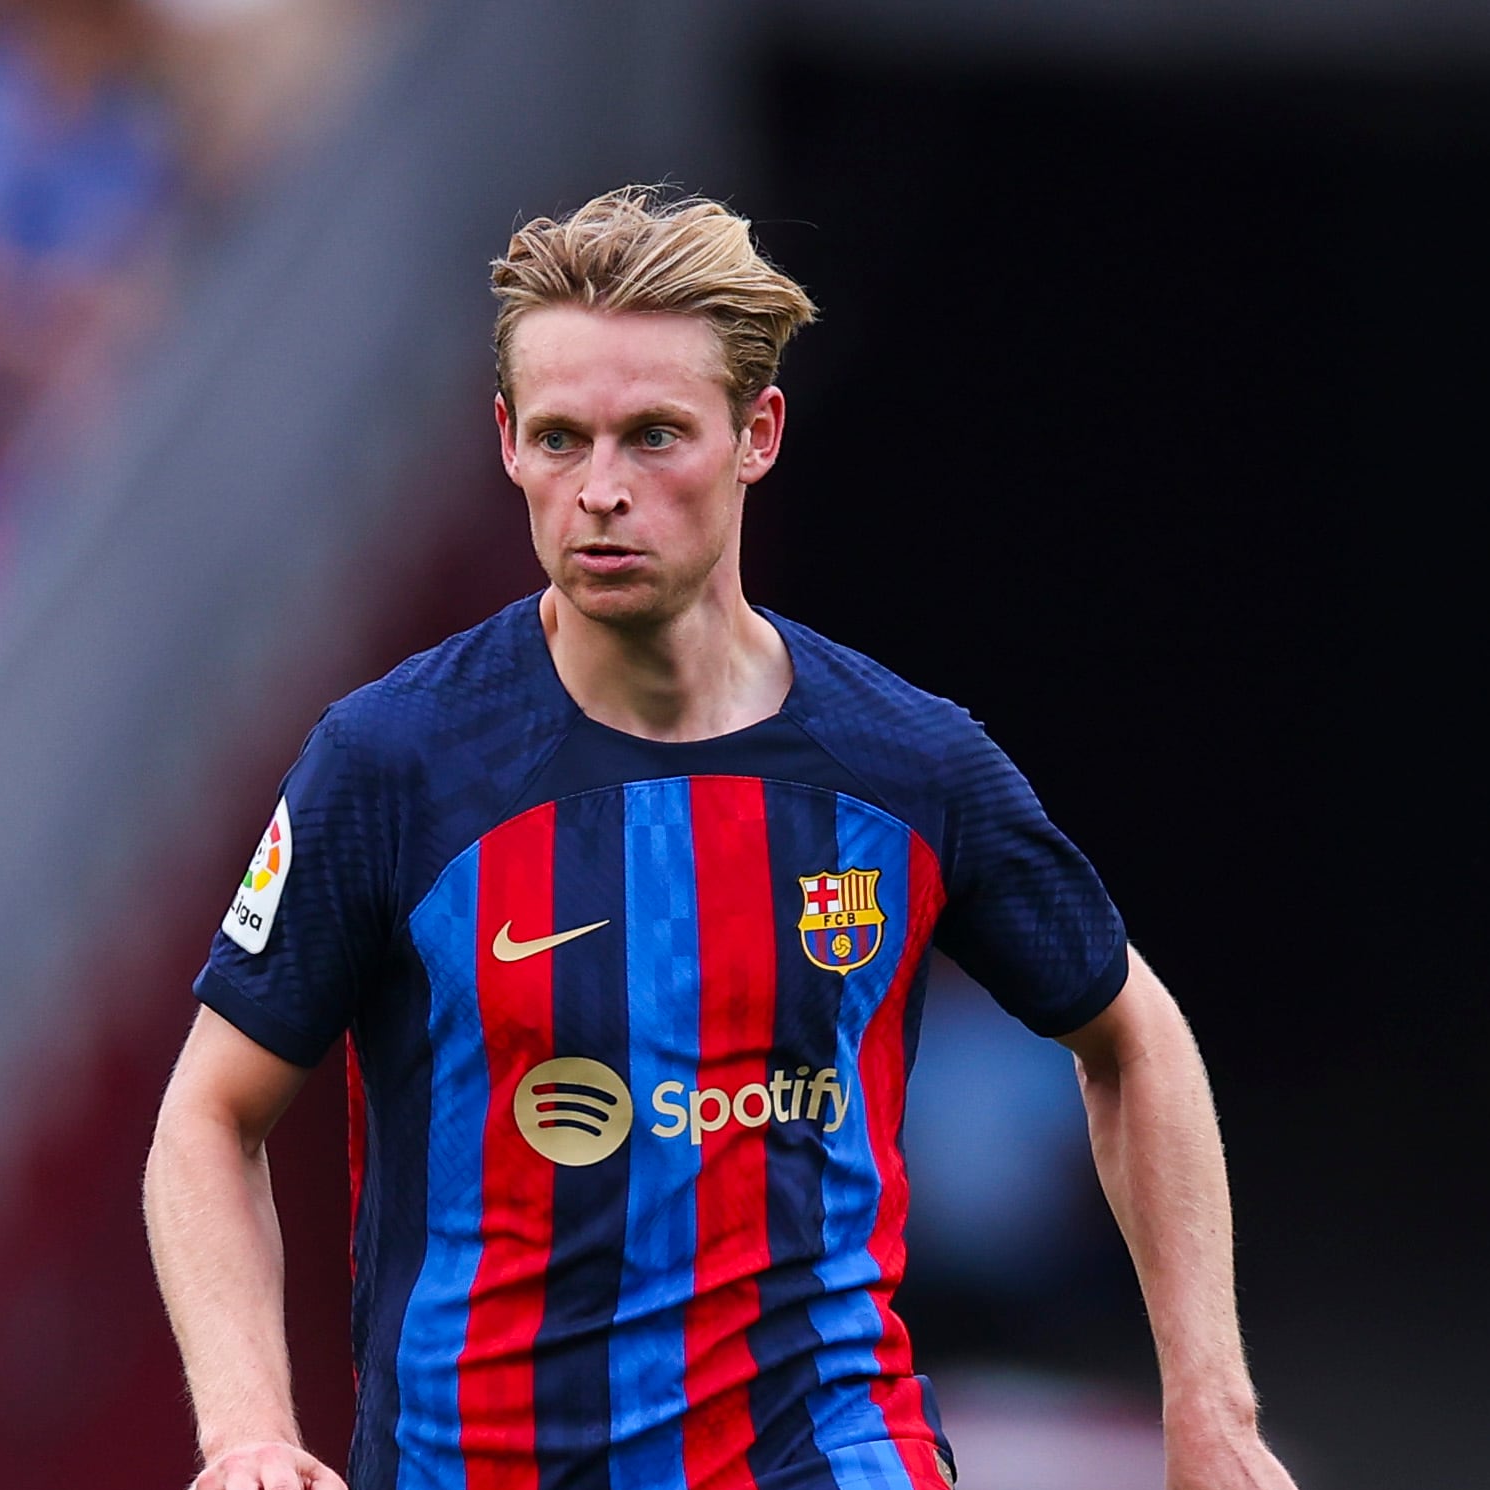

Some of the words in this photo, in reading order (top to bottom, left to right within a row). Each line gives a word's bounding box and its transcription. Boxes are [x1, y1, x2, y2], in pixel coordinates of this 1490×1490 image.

[230, 895, 263, 931] iga
[823, 912, 856, 927] FCB
[650, 1065, 851, 1146] Spotify
